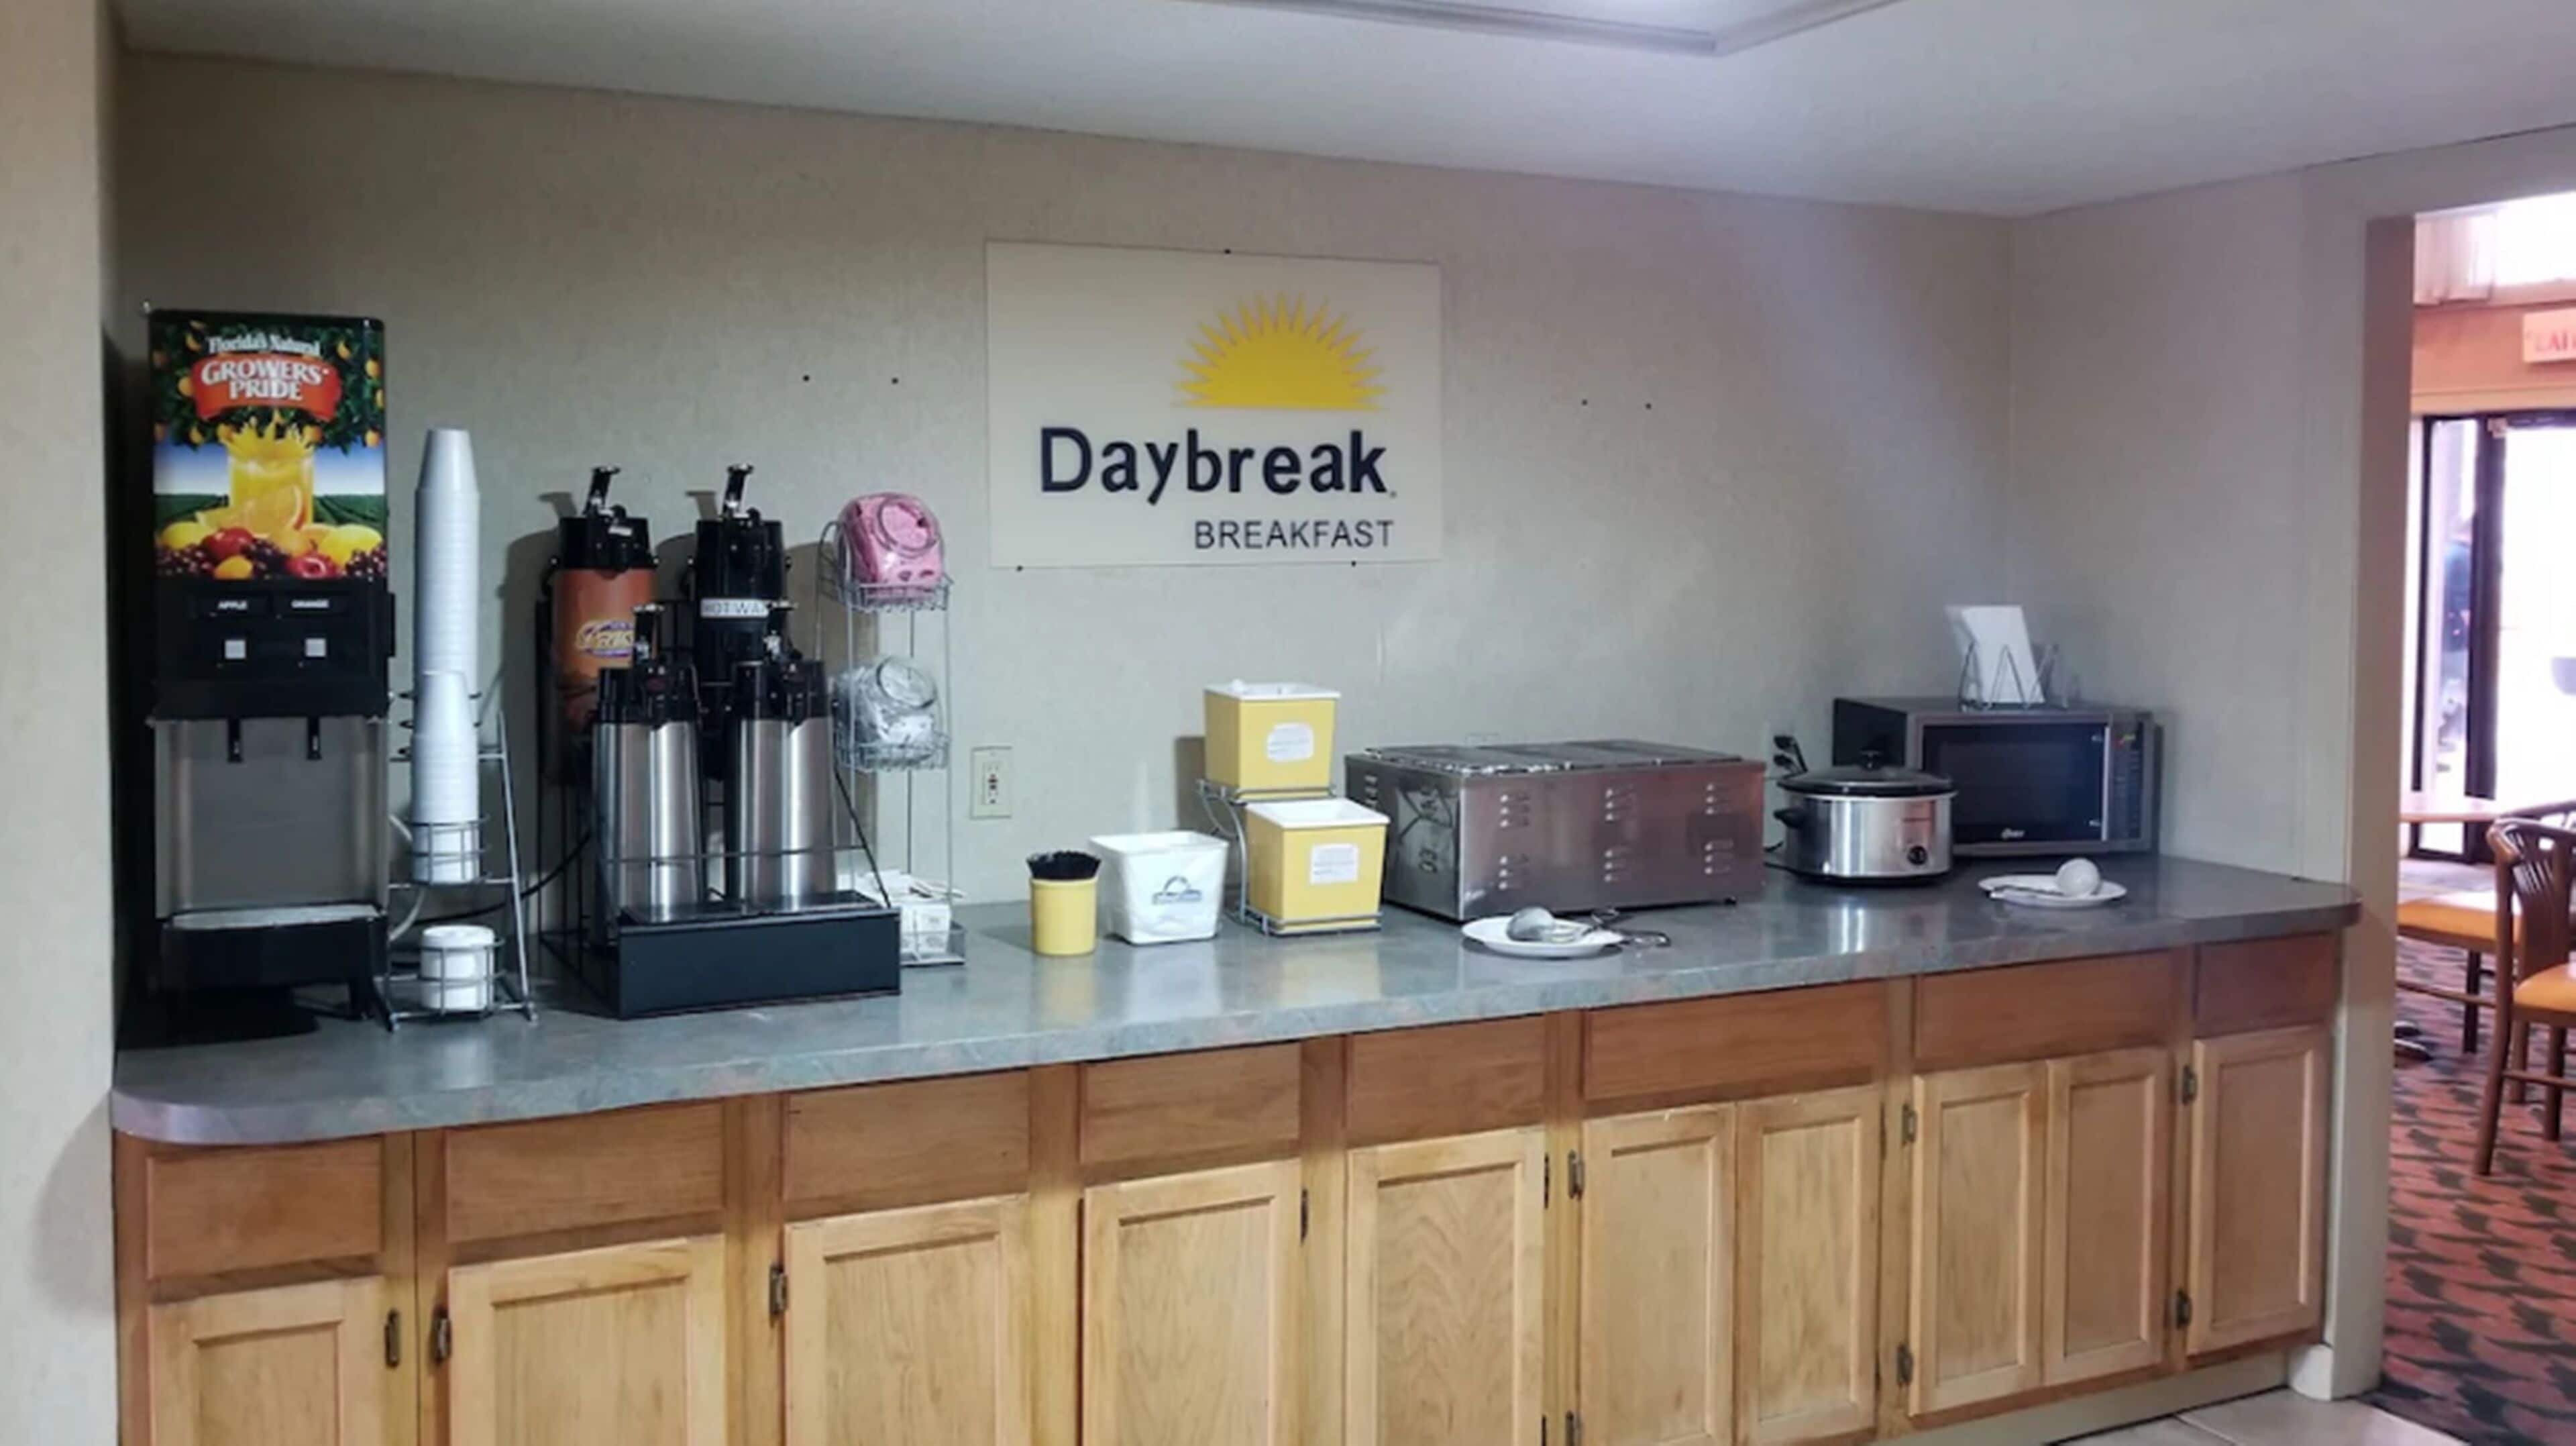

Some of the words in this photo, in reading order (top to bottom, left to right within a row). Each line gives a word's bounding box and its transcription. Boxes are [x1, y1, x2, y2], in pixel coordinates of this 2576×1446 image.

[270, 334, 321, 357] Natural
[229, 380, 304, 401] PRIDE
[1041, 427, 1387, 506] Daybreak
[1194, 520, 1394, 549] BREAKFAST
